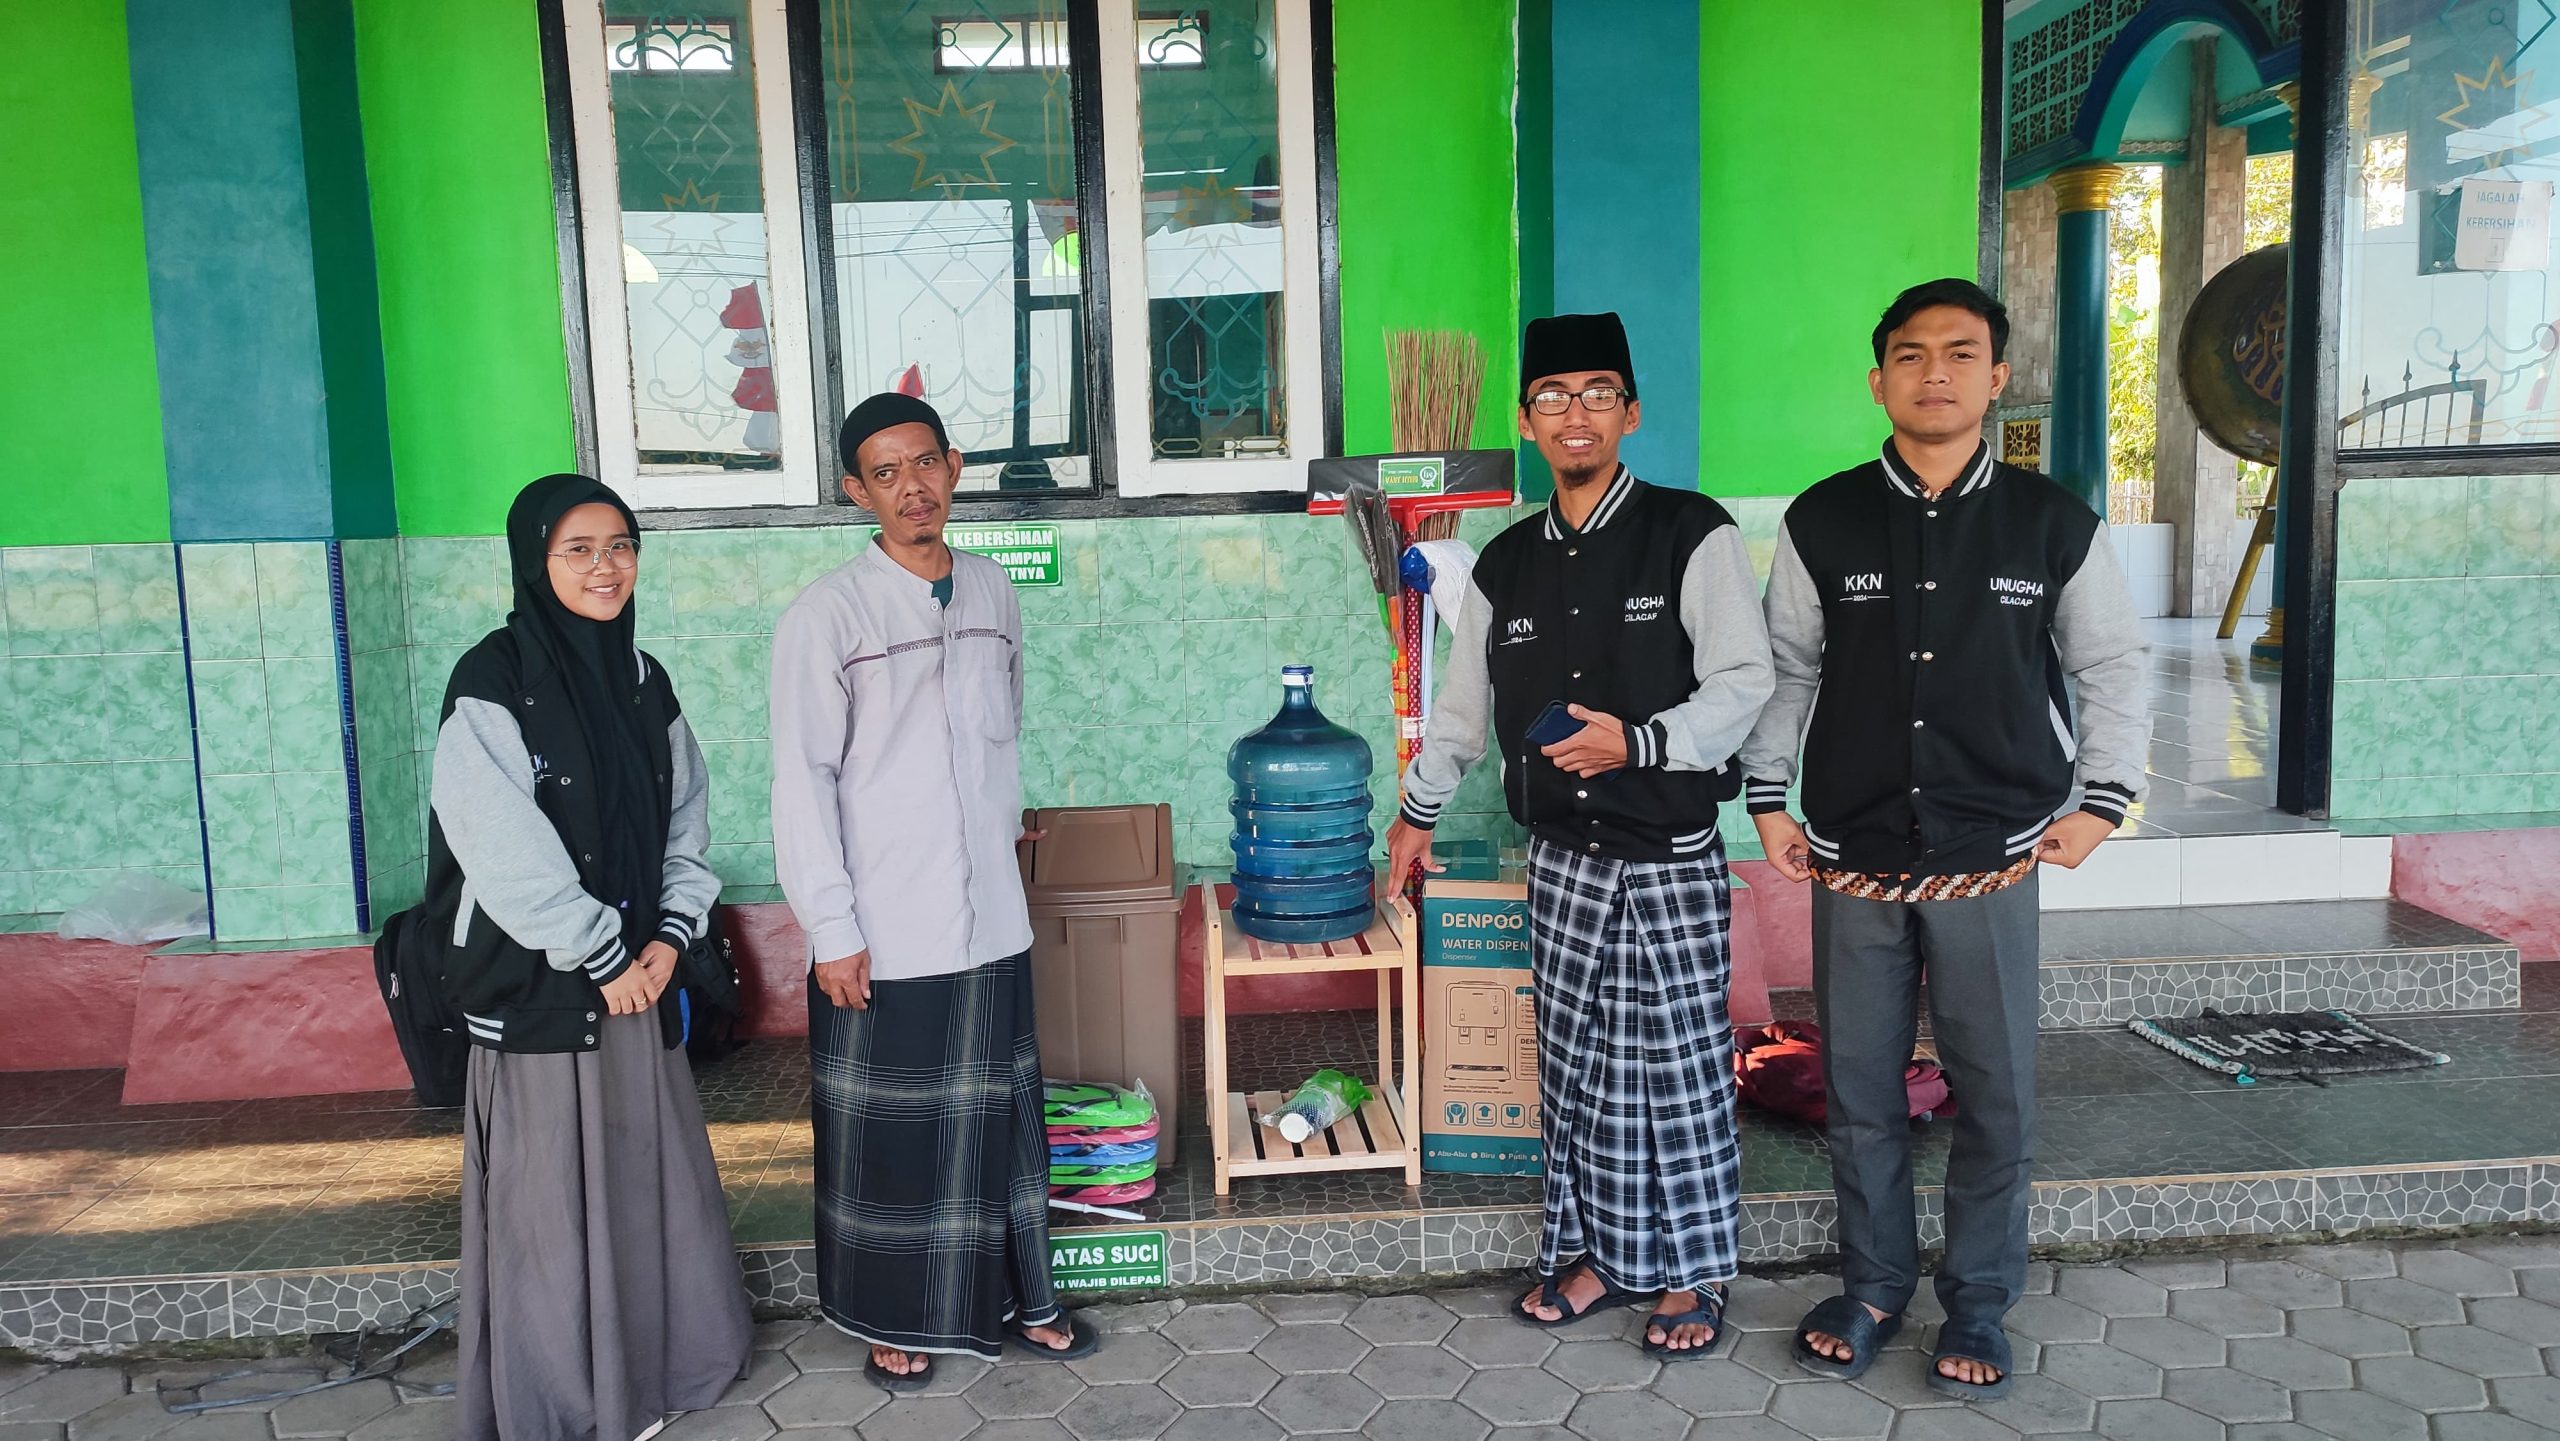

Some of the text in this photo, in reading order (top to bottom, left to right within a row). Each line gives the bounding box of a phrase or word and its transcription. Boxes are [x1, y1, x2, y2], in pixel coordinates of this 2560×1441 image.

[953, 530, 1053, 547] KEBERSIHAN
[991, 551, 1052, 566] SAMPAH
[1845, 572, 1883, 592] KKN
[1990, 577, 2044, 597] UNUGHA
[1441, 912, 1524, 930] DENPOO
[1441, 938, 1529, 951] WATER DISPEN
[1480, 1151, 1496, 1159] Biru
[1051, 1244, 1159, 1267] ATAS SUCI
[1068, 1277, 1108, 1288] WAJIB
[1110, 1274, 1162, 1287] DILEPAS
